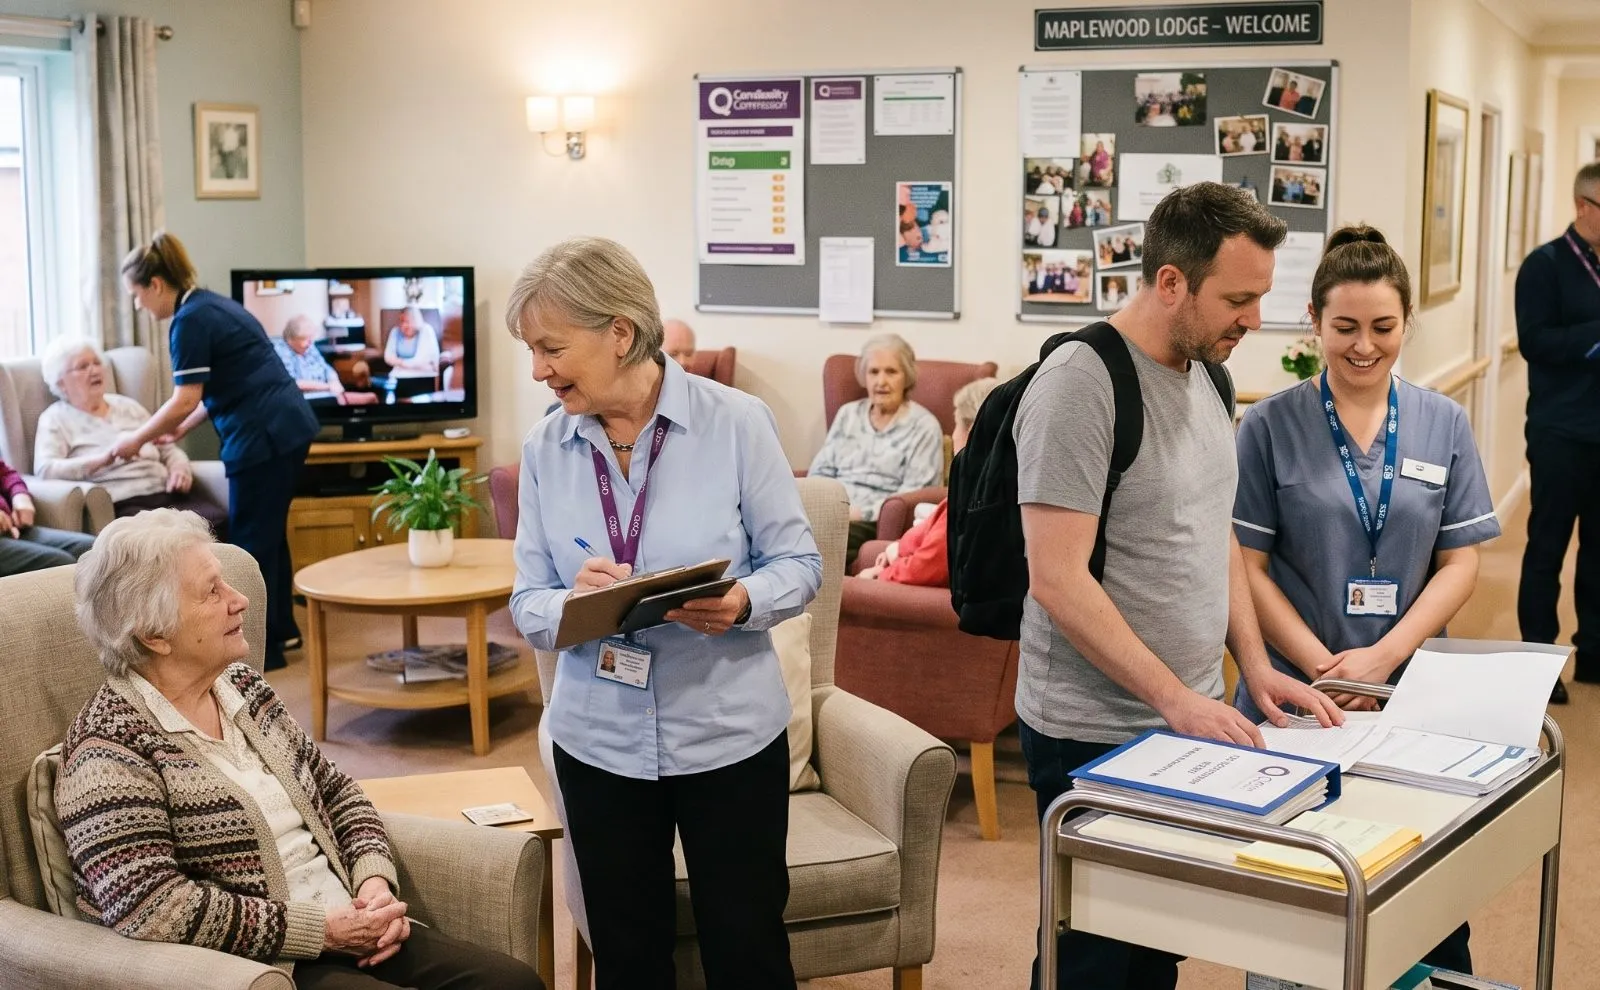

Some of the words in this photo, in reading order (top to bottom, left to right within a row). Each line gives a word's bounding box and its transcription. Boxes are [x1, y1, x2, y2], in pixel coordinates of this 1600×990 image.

[1044, 17, 1151, 39] MAPLEWOOD
[1154, 16, 1209, 37] LODGE
[1225, 13, 1311, 34] WELCOME
